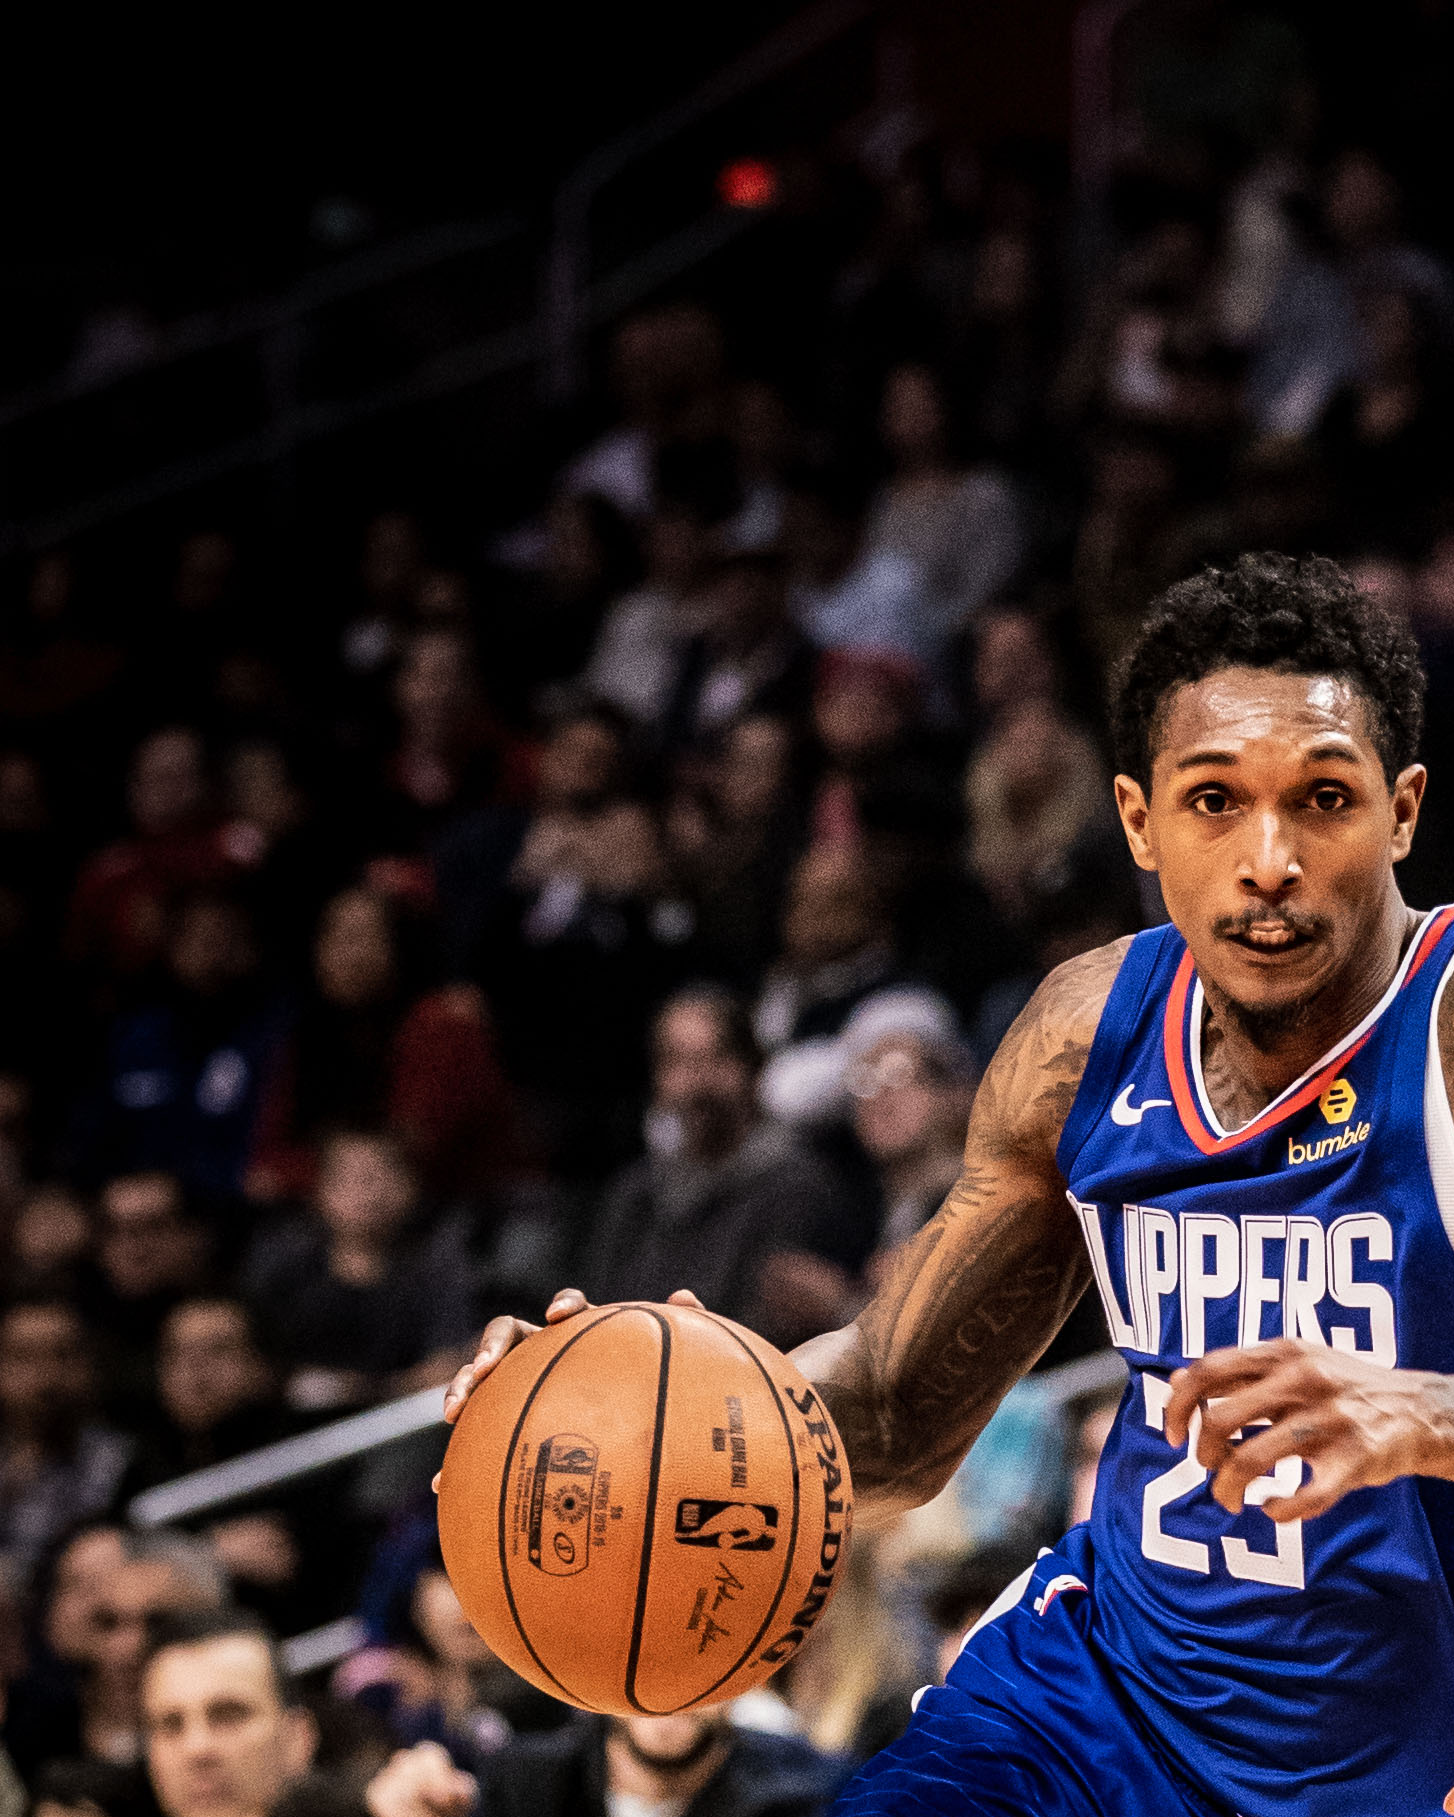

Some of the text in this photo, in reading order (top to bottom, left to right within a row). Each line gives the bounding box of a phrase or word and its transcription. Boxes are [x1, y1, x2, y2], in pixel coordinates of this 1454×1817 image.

[1288, 1121, 1371, 1165] bumble
[1066, 1190, 1398, 1370] LIPPERS
[682, 1503, 700, 1527] NBA
[760, 1387, 844, 1664] SPALDING
